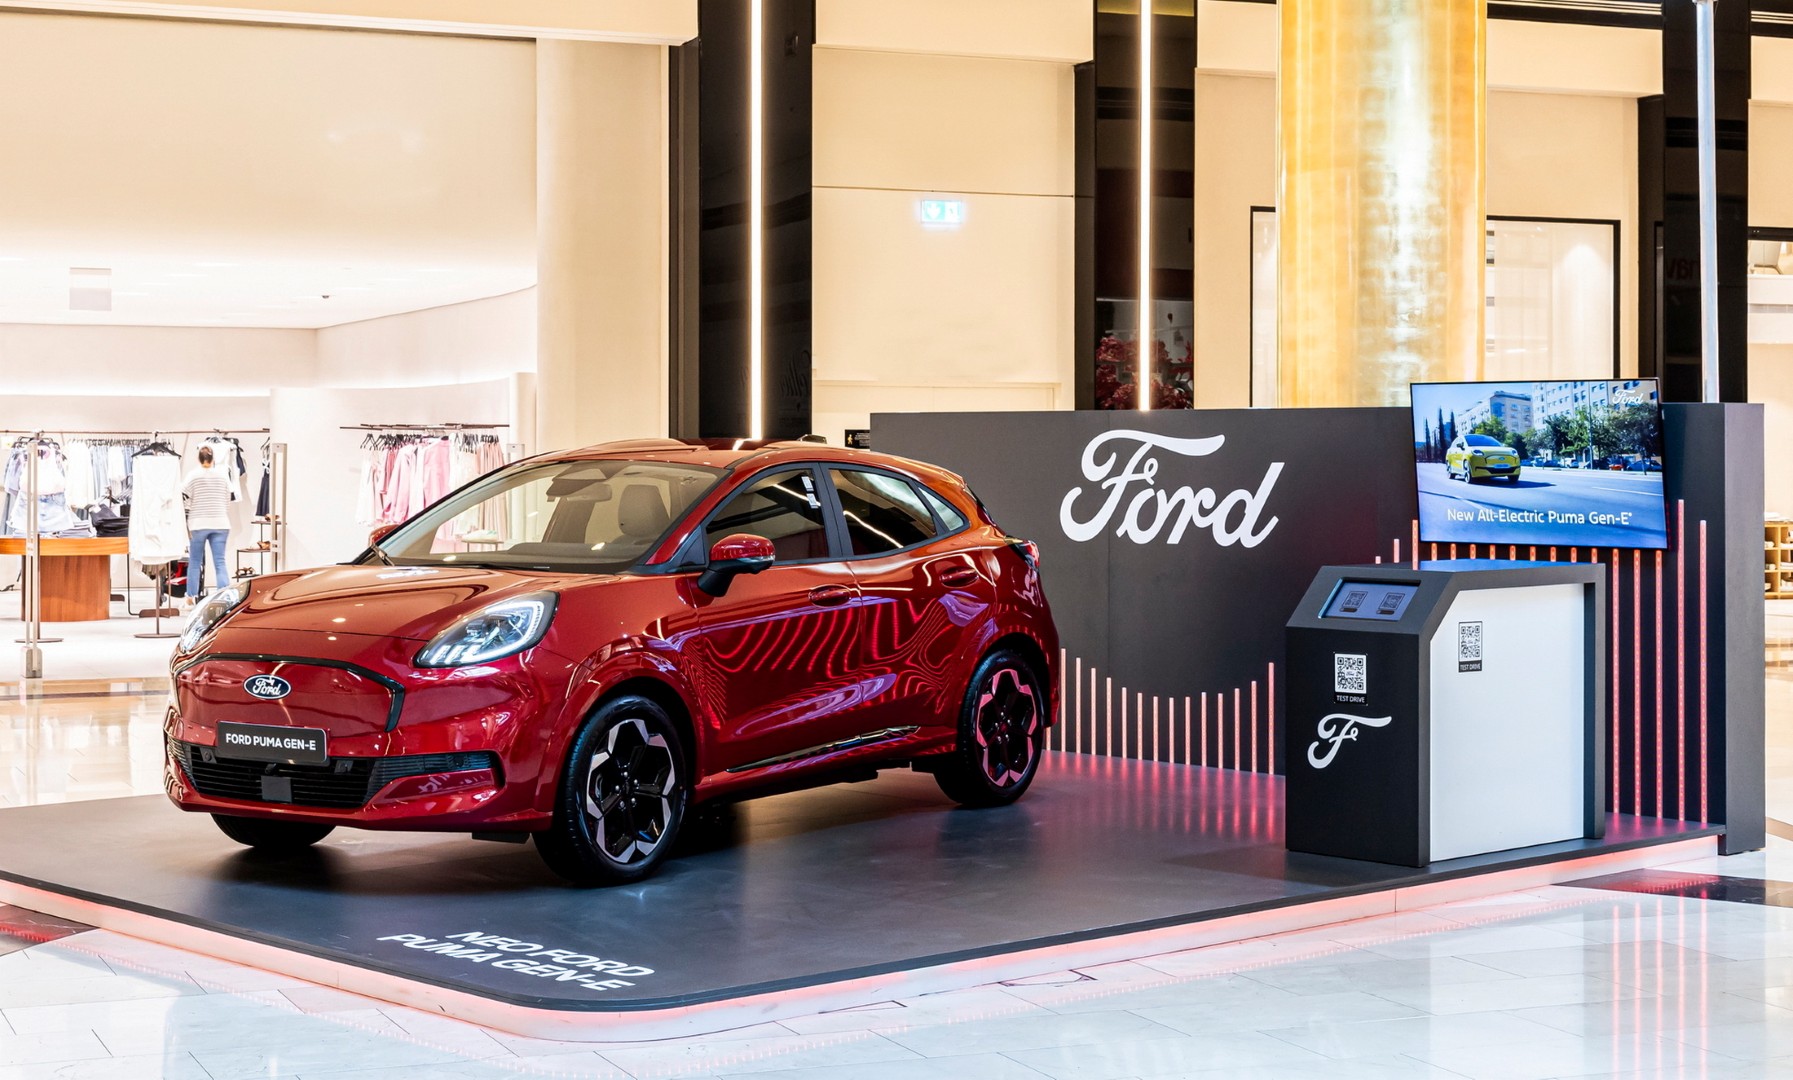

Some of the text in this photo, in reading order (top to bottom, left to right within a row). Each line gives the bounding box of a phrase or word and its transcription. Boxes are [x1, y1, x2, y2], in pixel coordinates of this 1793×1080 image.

[1612, 389, 1644, 404] Ford
[1060, 429, 1285, 548] Ford
[1447, 509, 1474, 521] New
[1477, 509, 1544, 523] All-Electric
[1548, 510, 1585, 524] Puma
[252, 677, 282, 696] Ford
[225, 733, 317, 751] FORD PUMA GEN-E
[376, 933, 636, 991] PUMA GEN-E
[445, 931, 655, 977] NEO FORD
